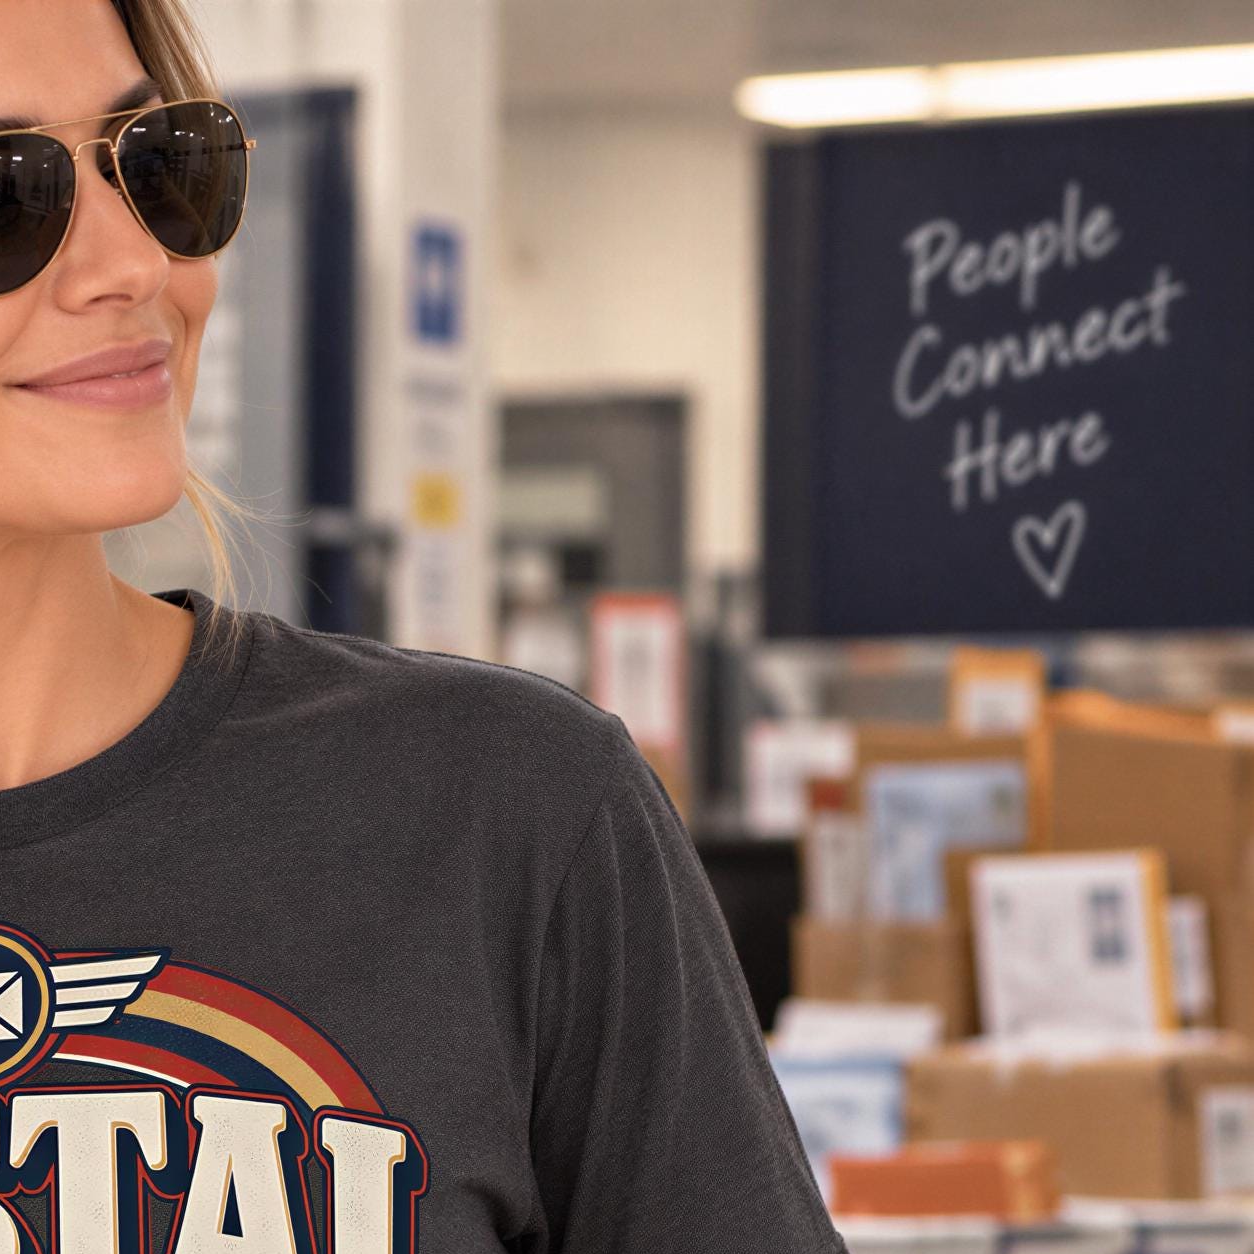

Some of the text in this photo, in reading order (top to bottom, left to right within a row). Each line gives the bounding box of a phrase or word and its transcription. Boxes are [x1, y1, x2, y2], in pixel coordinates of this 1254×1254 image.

[902, 180, 1120, 314] People
[893, 267, 1186, 419] Connect
[945, 407, 1109, 509] Here
